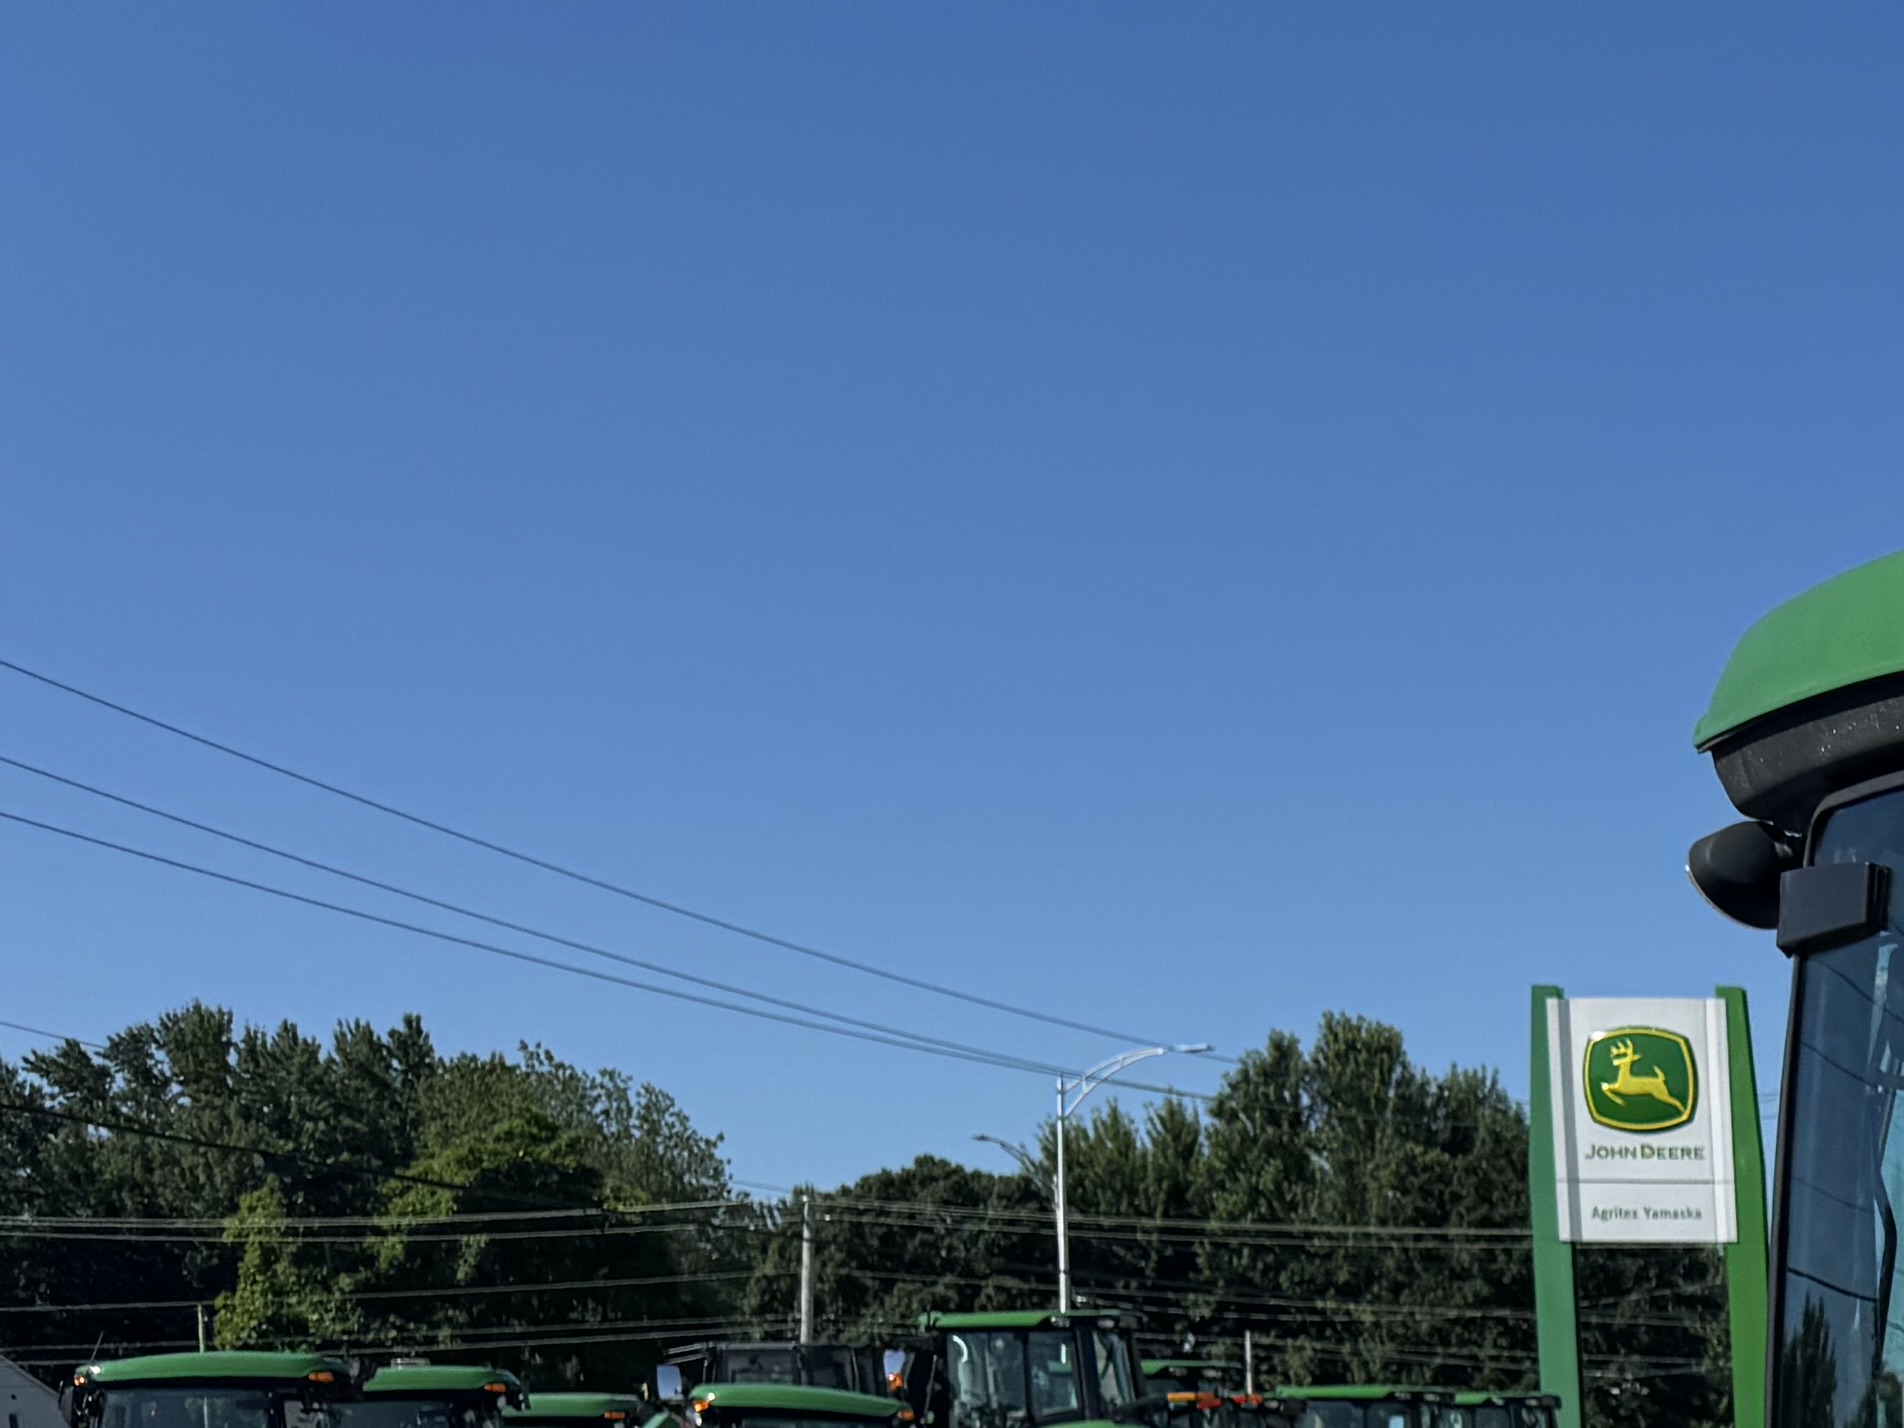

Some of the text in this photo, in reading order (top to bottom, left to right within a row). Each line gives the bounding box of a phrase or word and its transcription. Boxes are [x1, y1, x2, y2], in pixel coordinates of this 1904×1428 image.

[1585, 1144, 1705, 1160] JOHN DEERE
[1592, 1206, 1702, 1223] Agritex Yamaska
